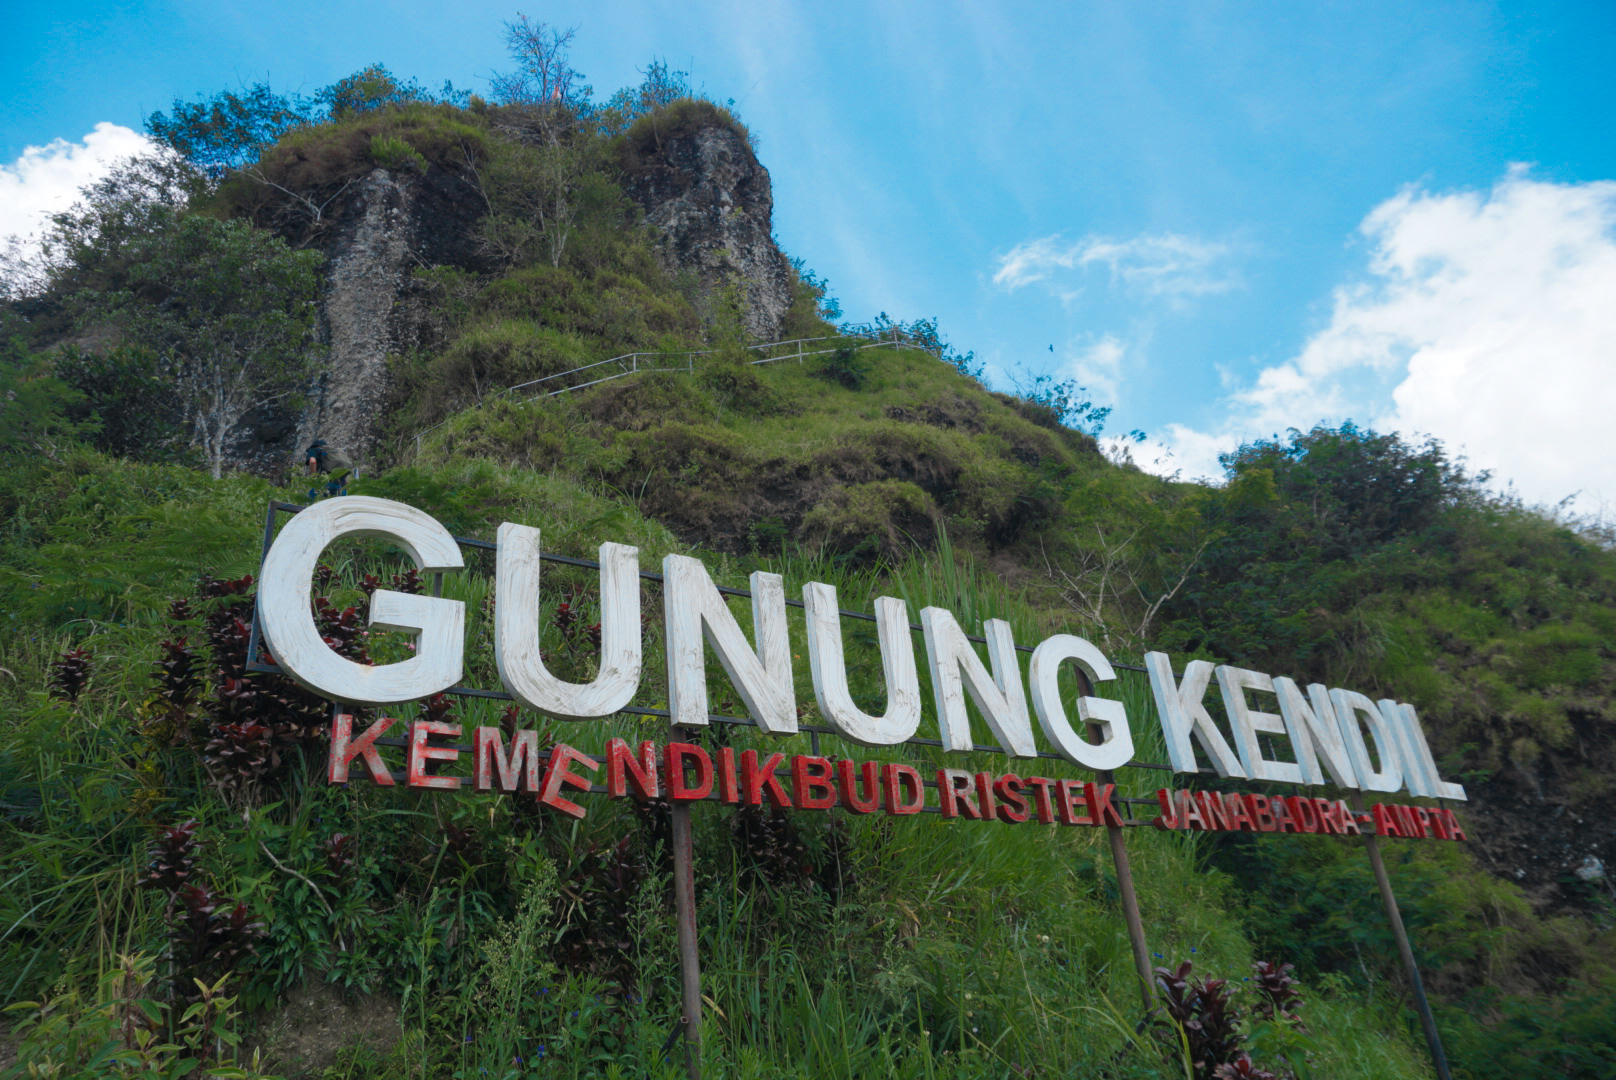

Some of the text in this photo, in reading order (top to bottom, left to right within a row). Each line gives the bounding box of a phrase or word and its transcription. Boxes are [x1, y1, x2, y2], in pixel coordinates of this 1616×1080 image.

[258, 496, 1468, 801] GUNUNG KENDIL
[328, 713, 925, 819] KEMENDIKBUD
[936, 768, 1125, 828] RISTEK
